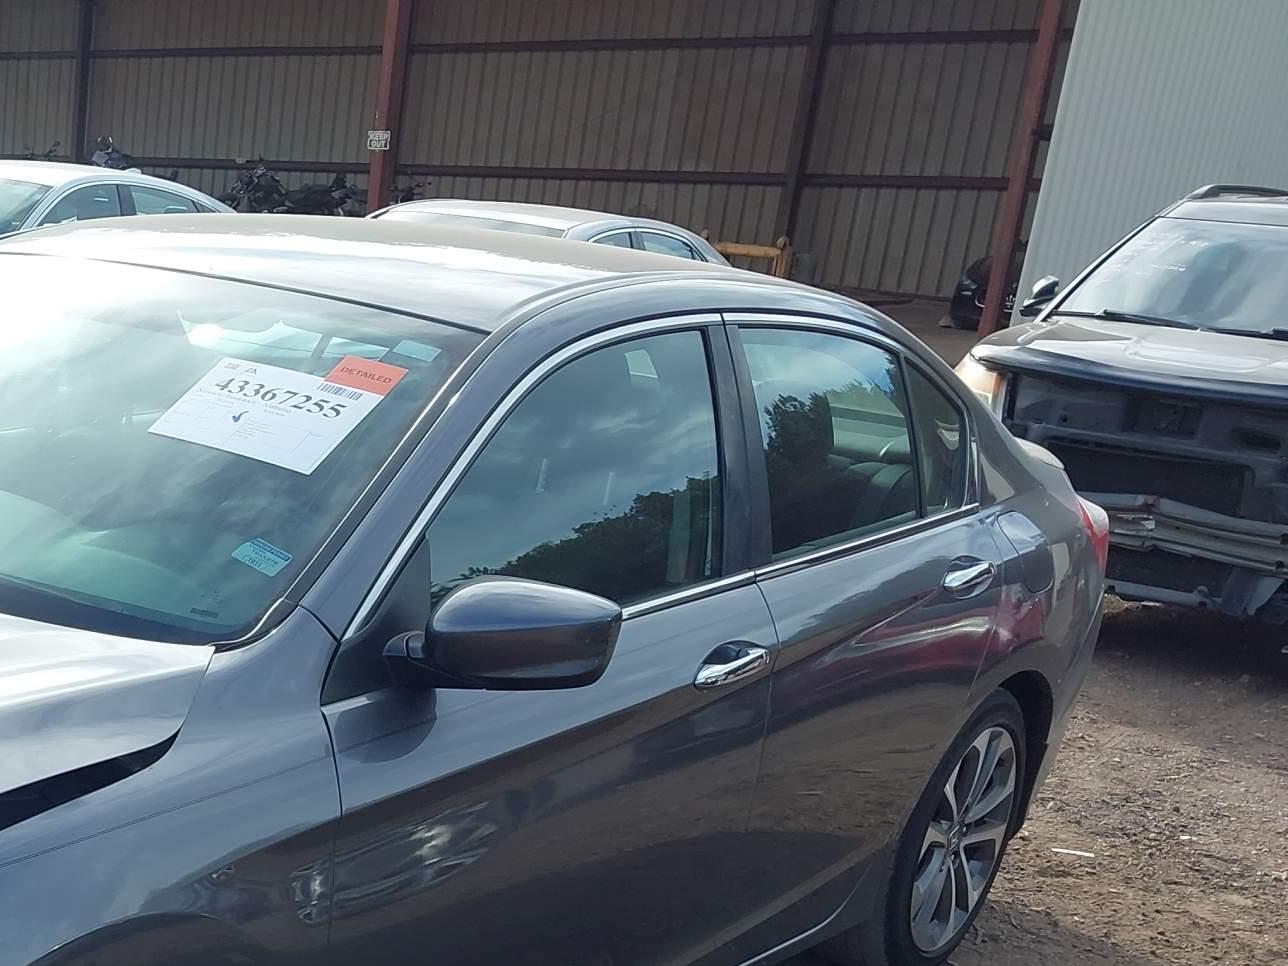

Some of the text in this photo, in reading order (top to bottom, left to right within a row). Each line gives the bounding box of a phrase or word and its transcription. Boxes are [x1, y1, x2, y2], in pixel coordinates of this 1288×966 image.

[370, 140, 386, 148] OUT
[340, 366, 392, 384] DETAILED
[215, 377, 349, 419] 43367255
